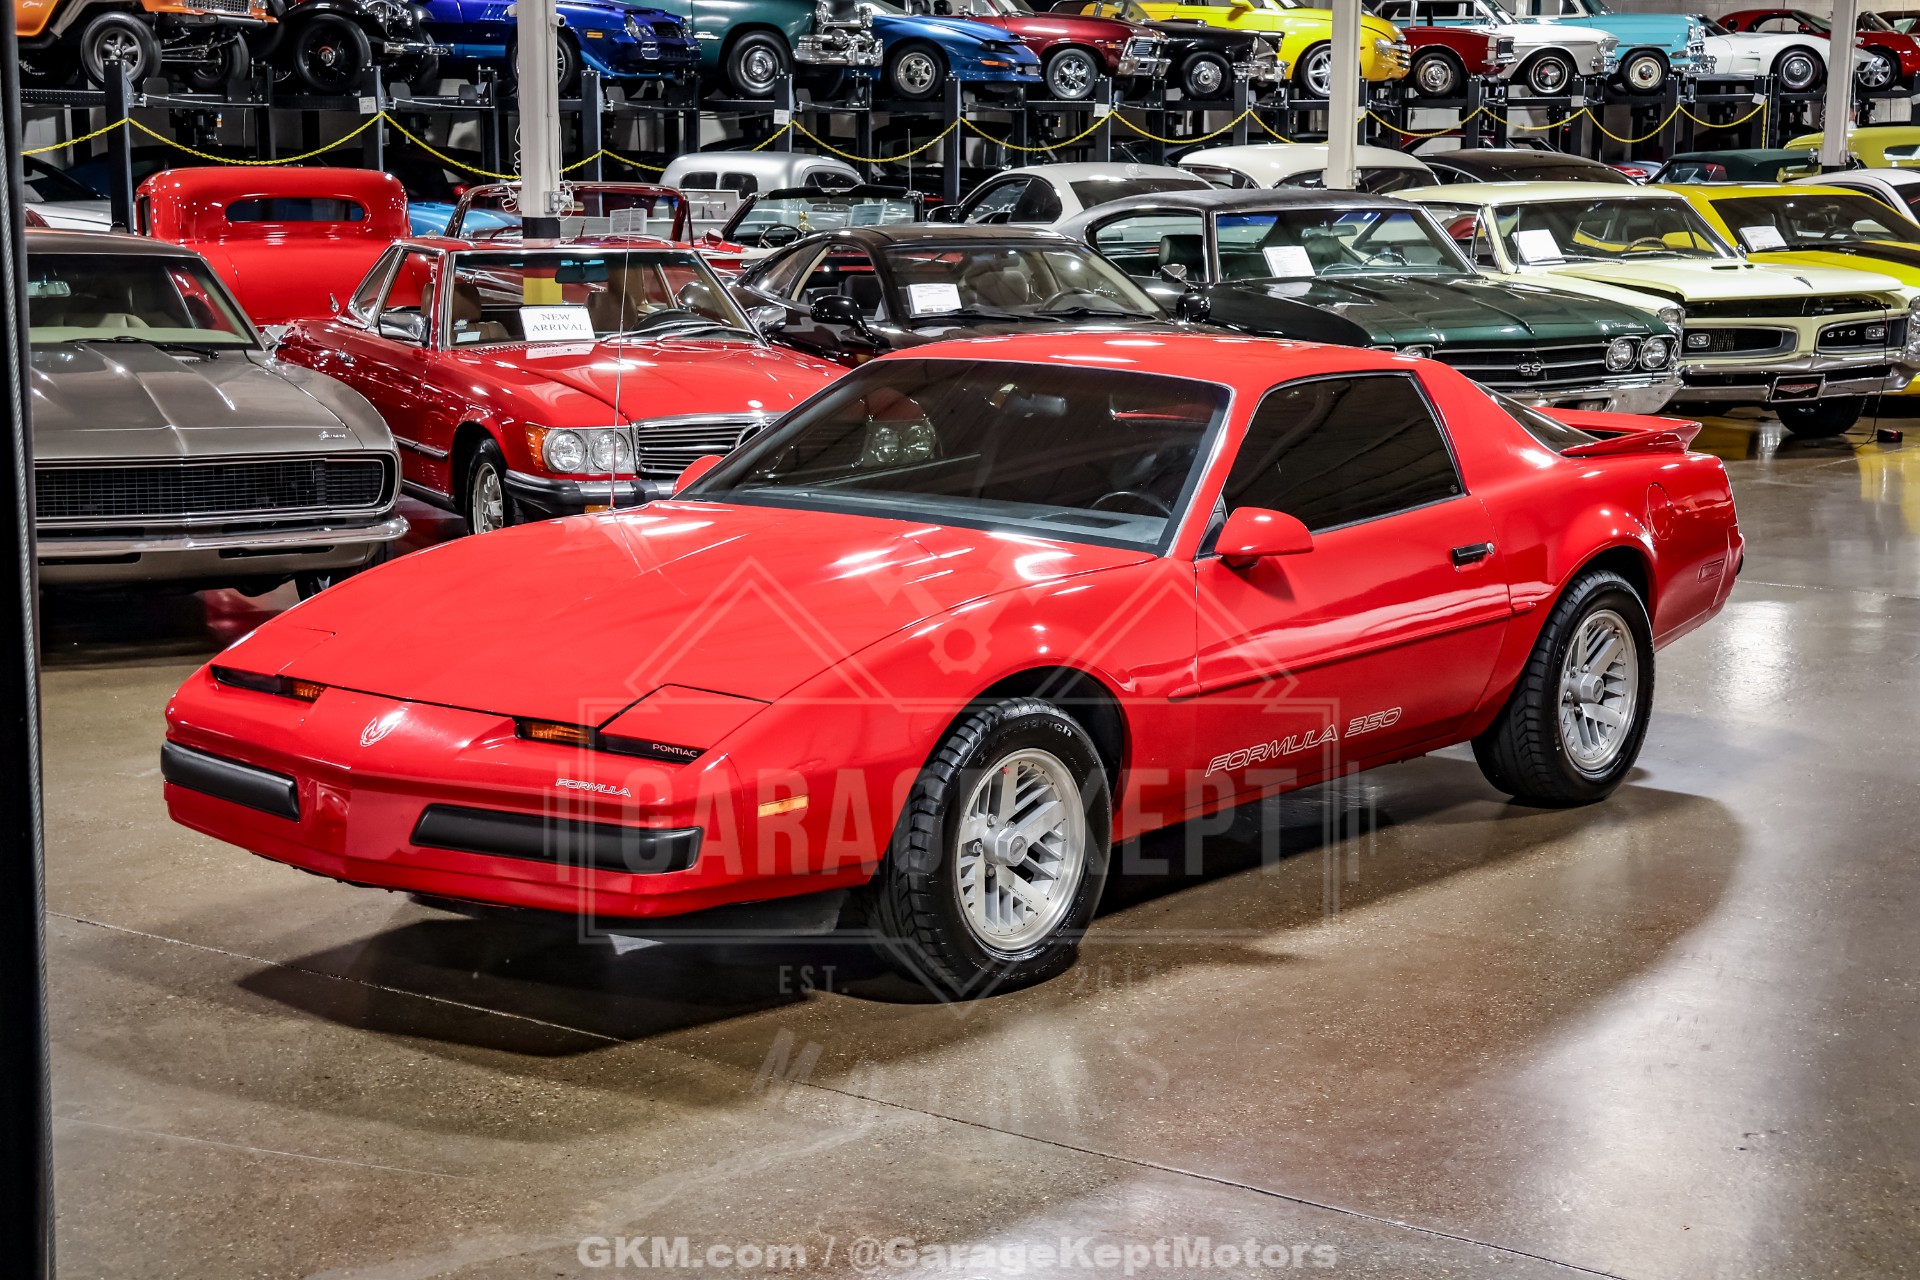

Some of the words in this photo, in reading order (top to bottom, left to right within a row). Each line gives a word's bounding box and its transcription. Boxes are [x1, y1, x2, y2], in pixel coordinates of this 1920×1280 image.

[1826, 330, 1856, 338] GTO
[1519, 362, 1542, 373] SS
[1205, 724, 1338, 778] FORMULA
[1344, 706, 1402, 739] 350
[652, 743, 698, 758] PONTIAC
[555, 777, 632, 798] FORMULA
